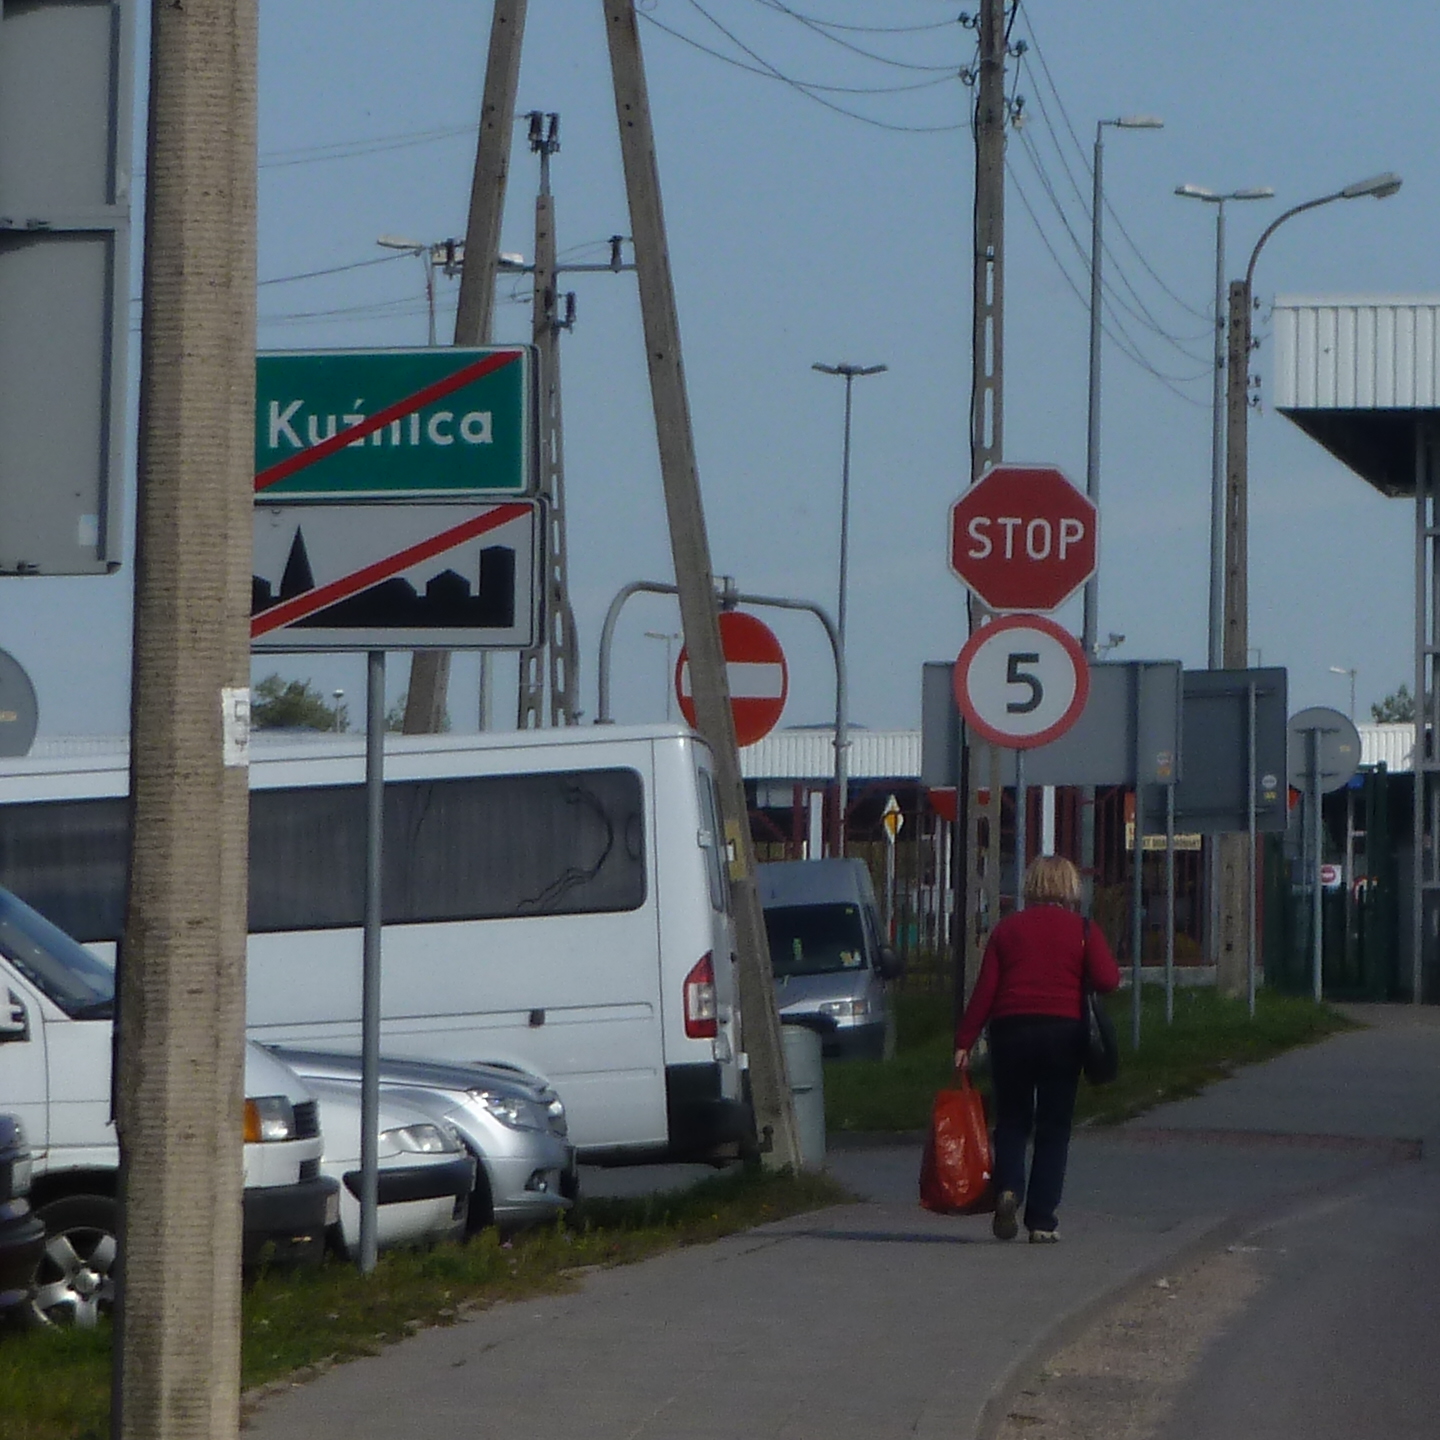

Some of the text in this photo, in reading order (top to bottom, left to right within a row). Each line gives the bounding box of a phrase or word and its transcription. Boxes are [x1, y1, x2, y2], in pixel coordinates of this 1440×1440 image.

[268, 398, 494, 449] Kuźnica
[967, 516, 1085, 561] STOP
[1006, 652, 1044, 714] 5
